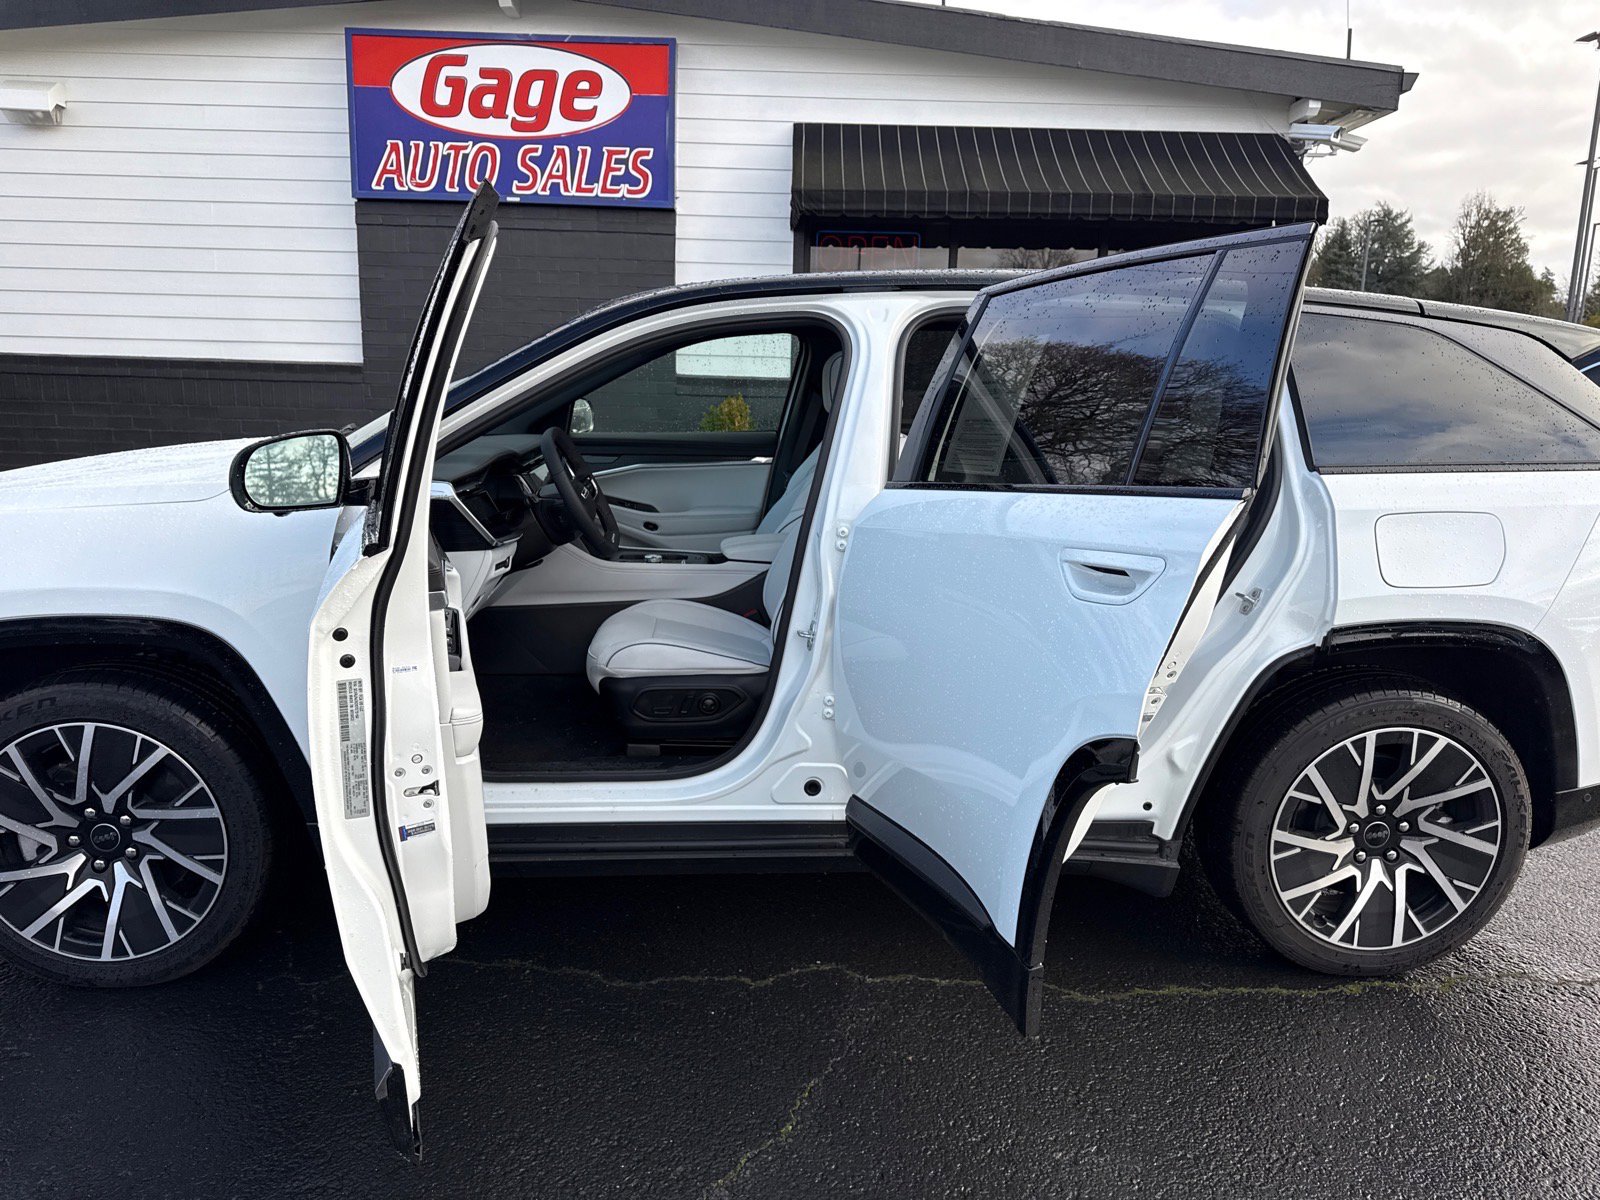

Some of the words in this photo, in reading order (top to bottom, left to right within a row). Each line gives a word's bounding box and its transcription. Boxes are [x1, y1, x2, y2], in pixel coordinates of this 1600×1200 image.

[420, 54, 603, 132] Gage
[372, 141, 501, 192] AUTO
[513, 144, 653, 198] SALES
[820, 235, 917, 270] OPEN
